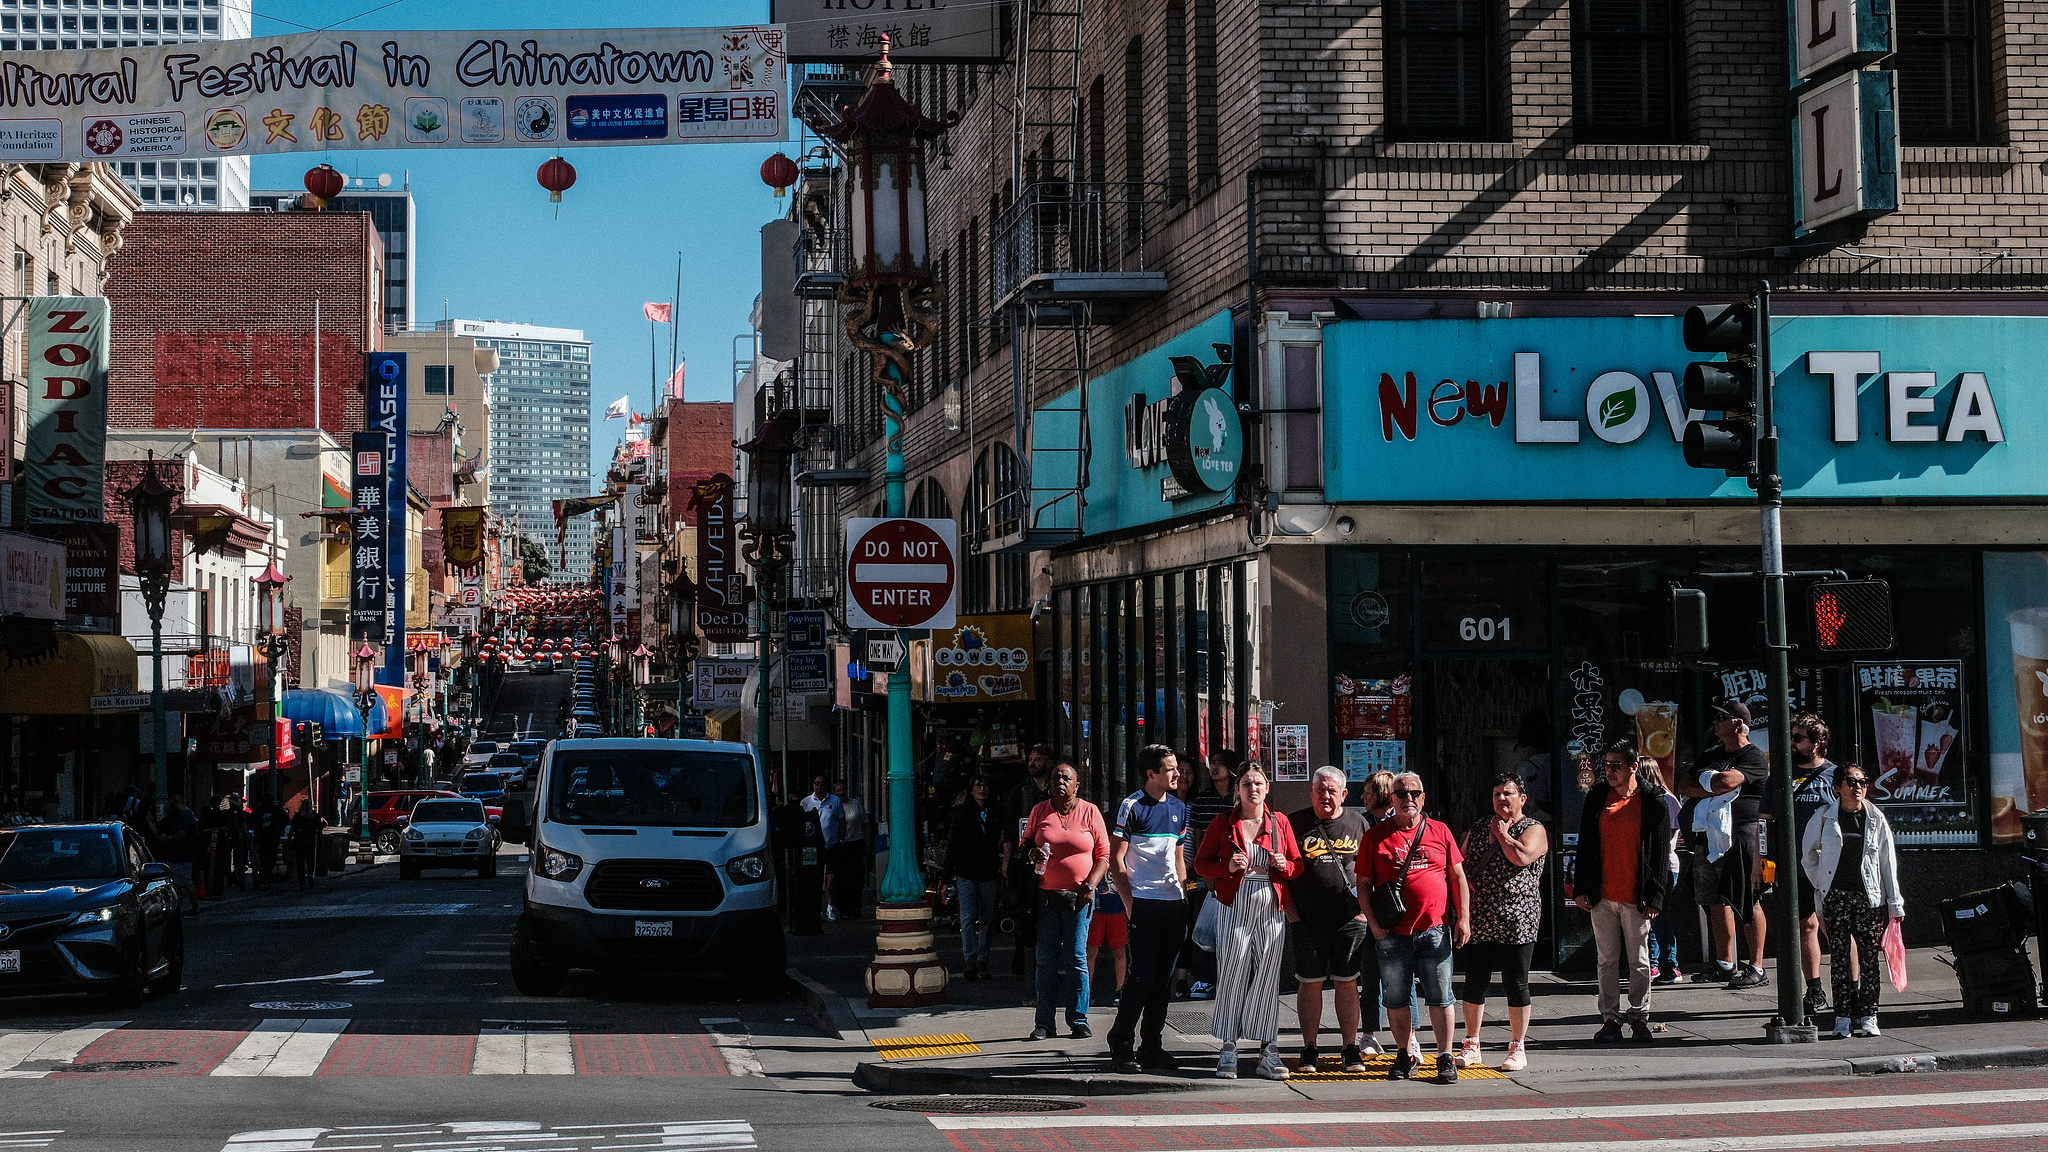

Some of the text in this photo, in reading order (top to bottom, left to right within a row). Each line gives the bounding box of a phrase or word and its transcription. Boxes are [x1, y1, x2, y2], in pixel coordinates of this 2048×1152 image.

[165, 41, 357, 102] Festival
[382, 40, 430, 88] in
[456, 38, 714, 88] Chinatown
[591, 106, 665, 120] 美中文化促進會
[679, 96, 776, 123] 星島日報
[129, 117, 170, 126] CHINESE
[262, 104, 391, 146] 文化節
[16, 130, 58, 139] Heritage
[129, 125, 185, 135] HISTORICAL
[0, 140, 53, 150] oundation
[129, 135, 170, 144] SOCIETY
[130, 145, 173, 153] AMERICA
[1378, 351, 2006, 444] New LOV TEA
[38, 310, 92, 500] ZODIAC
[1195, 445, 1209, 457] New
[1220, 460, 1233, 472] TEA
[30, 507, 99, 519] STATION
[356, 487, 382, 600] 華美銀行
[450, 524, 478, 551] 龍
[865, 541, 939, 558] DO NOT
[66, 567, 106, 578] HISTORY
[66, 583, 106, 593] CULTURE
[871, 589, 931, 606] ENTER
[701, 612, 729, 625] Dee
[788, 615, 823, 625] Pay here
[1459, 617, 1511, 641] 601
[869, 643, 894, 659] ONE WAY
[941, 651, 1009, 662] POWER
[790, 656, 816, 666] Pay by
[717, 665, 742, 676] Dee
[699, 666, 713, 700] 美之屋
[92, 697, 149, 707] Jack Kerouac
[1874, 767, 1955, 801] SUMMER
